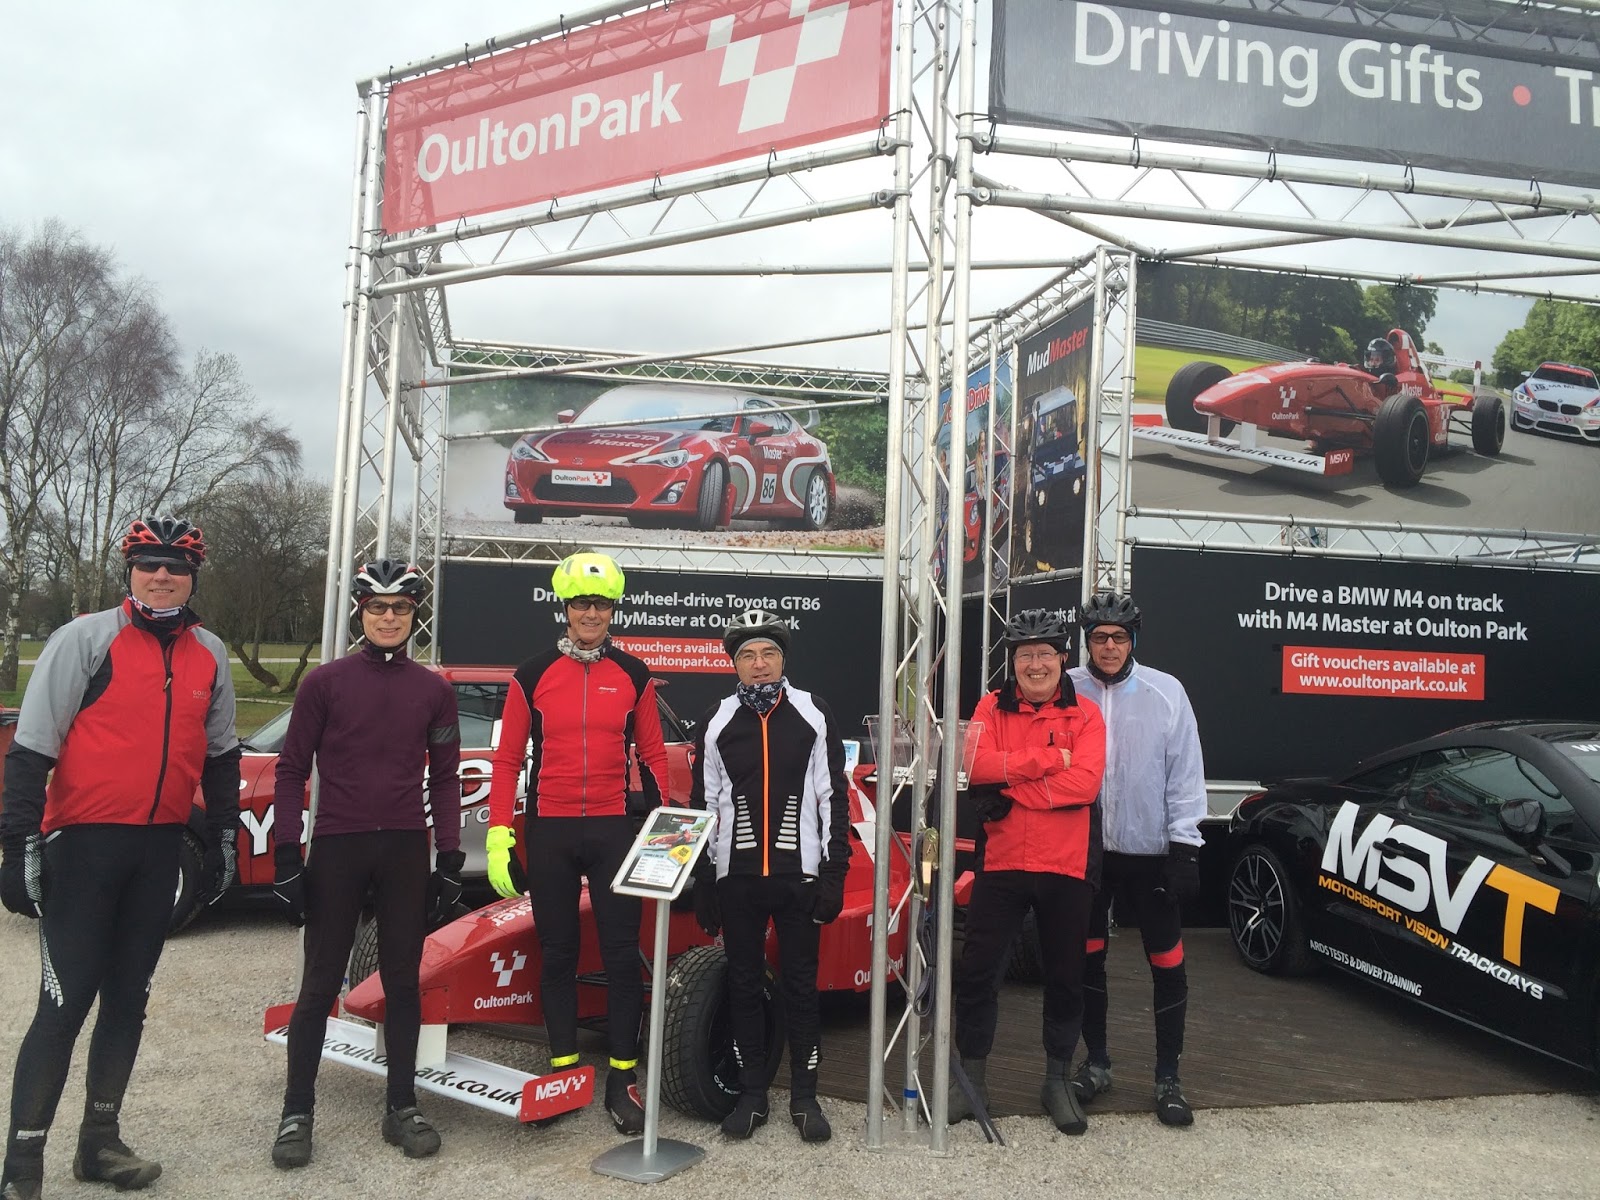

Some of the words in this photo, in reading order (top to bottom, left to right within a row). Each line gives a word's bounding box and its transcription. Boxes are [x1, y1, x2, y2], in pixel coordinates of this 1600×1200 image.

[1075, 4, 1318, 108] Driving
[1338, 39, 1484, 112] Gifts
[416, 70, 684, 183] OultonPark
[1026, 326, 1089, 377] MudMaster
[1271, 411, 1300, 420] OultonPark
[588, 438, 652, 450] Master
[590, 431, 661, 442] TOYOTA
[554, 473, 591, 482] OultonPark
[762, 477, 776, 499] 86
[725, 593, 778, 612] Toyota
[780, 596, 821, 612] GT86
[1264, 581, 1318, 604] Drive
[1321, 588, 1334, 604] a
[1338, 586, 1390, 607] BMW
[1393, 588, 1424, 609] M4
[1427, 593, 1452, 610] on
[1456, 593, 1504, 613] track
[690, 613, 705, 627] at
[1237, 609, 1283, 630] with
[1286, 611, 1319, 632] M4
[1321, 613, 1390, 636] Master
[1393, 617, 1413, 637] at
[1415, 617, 1482, 640] Oulton
[1485, 621, 1529, 642] Park
[627, 641, 682, 653] vouchers
[684, 642, 727, 655] availab
[1290, 652, 1321, 670] Gift
[1322, 654, 1391, 673] vouchers
[1392, 656, 1460, 676] available
[1461, 661, 1476, 676] at
[1299, 673, 1468, 694] www.oultonpark.co.uk
[1320, 799, 1561, 967] MSVT
[1318, 874, 1402, 923] MOTORSPORT
[1404, 914, 1450, 950] VISION
[1449, 940, 1544, 1001] TRACKDAYS
[1309, 939, 1330, 956] ARDS
[1328, 946, 1350, 965] TESTS
[1349, 955, 1356, 968] &
[1355, 957, 1383, 980] DRIVER
[1382, 969, 1423, 998] TRAINING
[473, 991, 534, 1010] OultonPark
